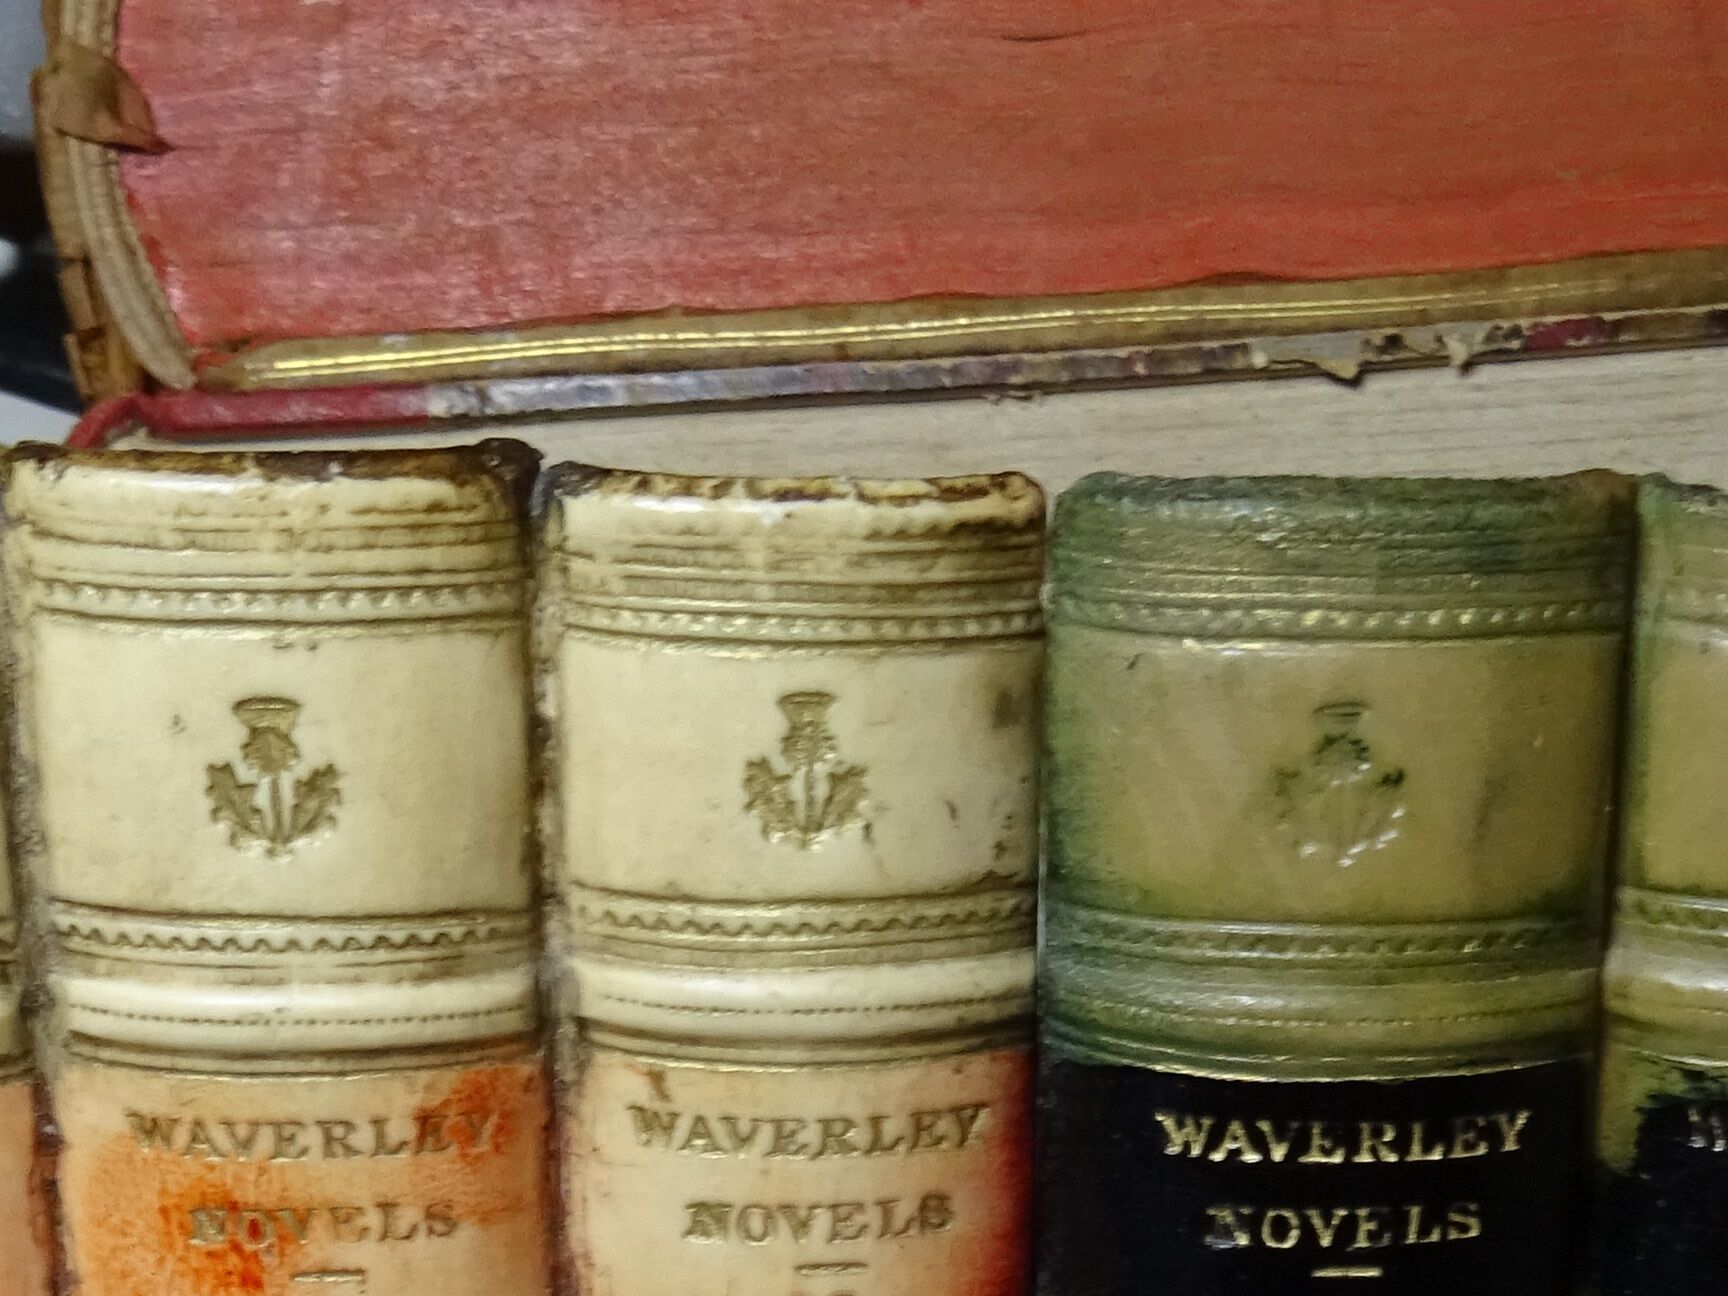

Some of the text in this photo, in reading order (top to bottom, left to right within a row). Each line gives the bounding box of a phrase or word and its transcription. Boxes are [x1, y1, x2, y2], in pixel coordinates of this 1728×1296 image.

[124, 1107, 498, 1161] WAVERLEY
[627, 1102, 990, 1160] WAVERLEY
[1155, 1109, 1532, 1163] WAVERLEY
[188, 1201, 459, 1247] NOVELS
[682, 1191, 955, 1246] NOVELS
[1205, 1203, 1482, 1250] NOVELS
